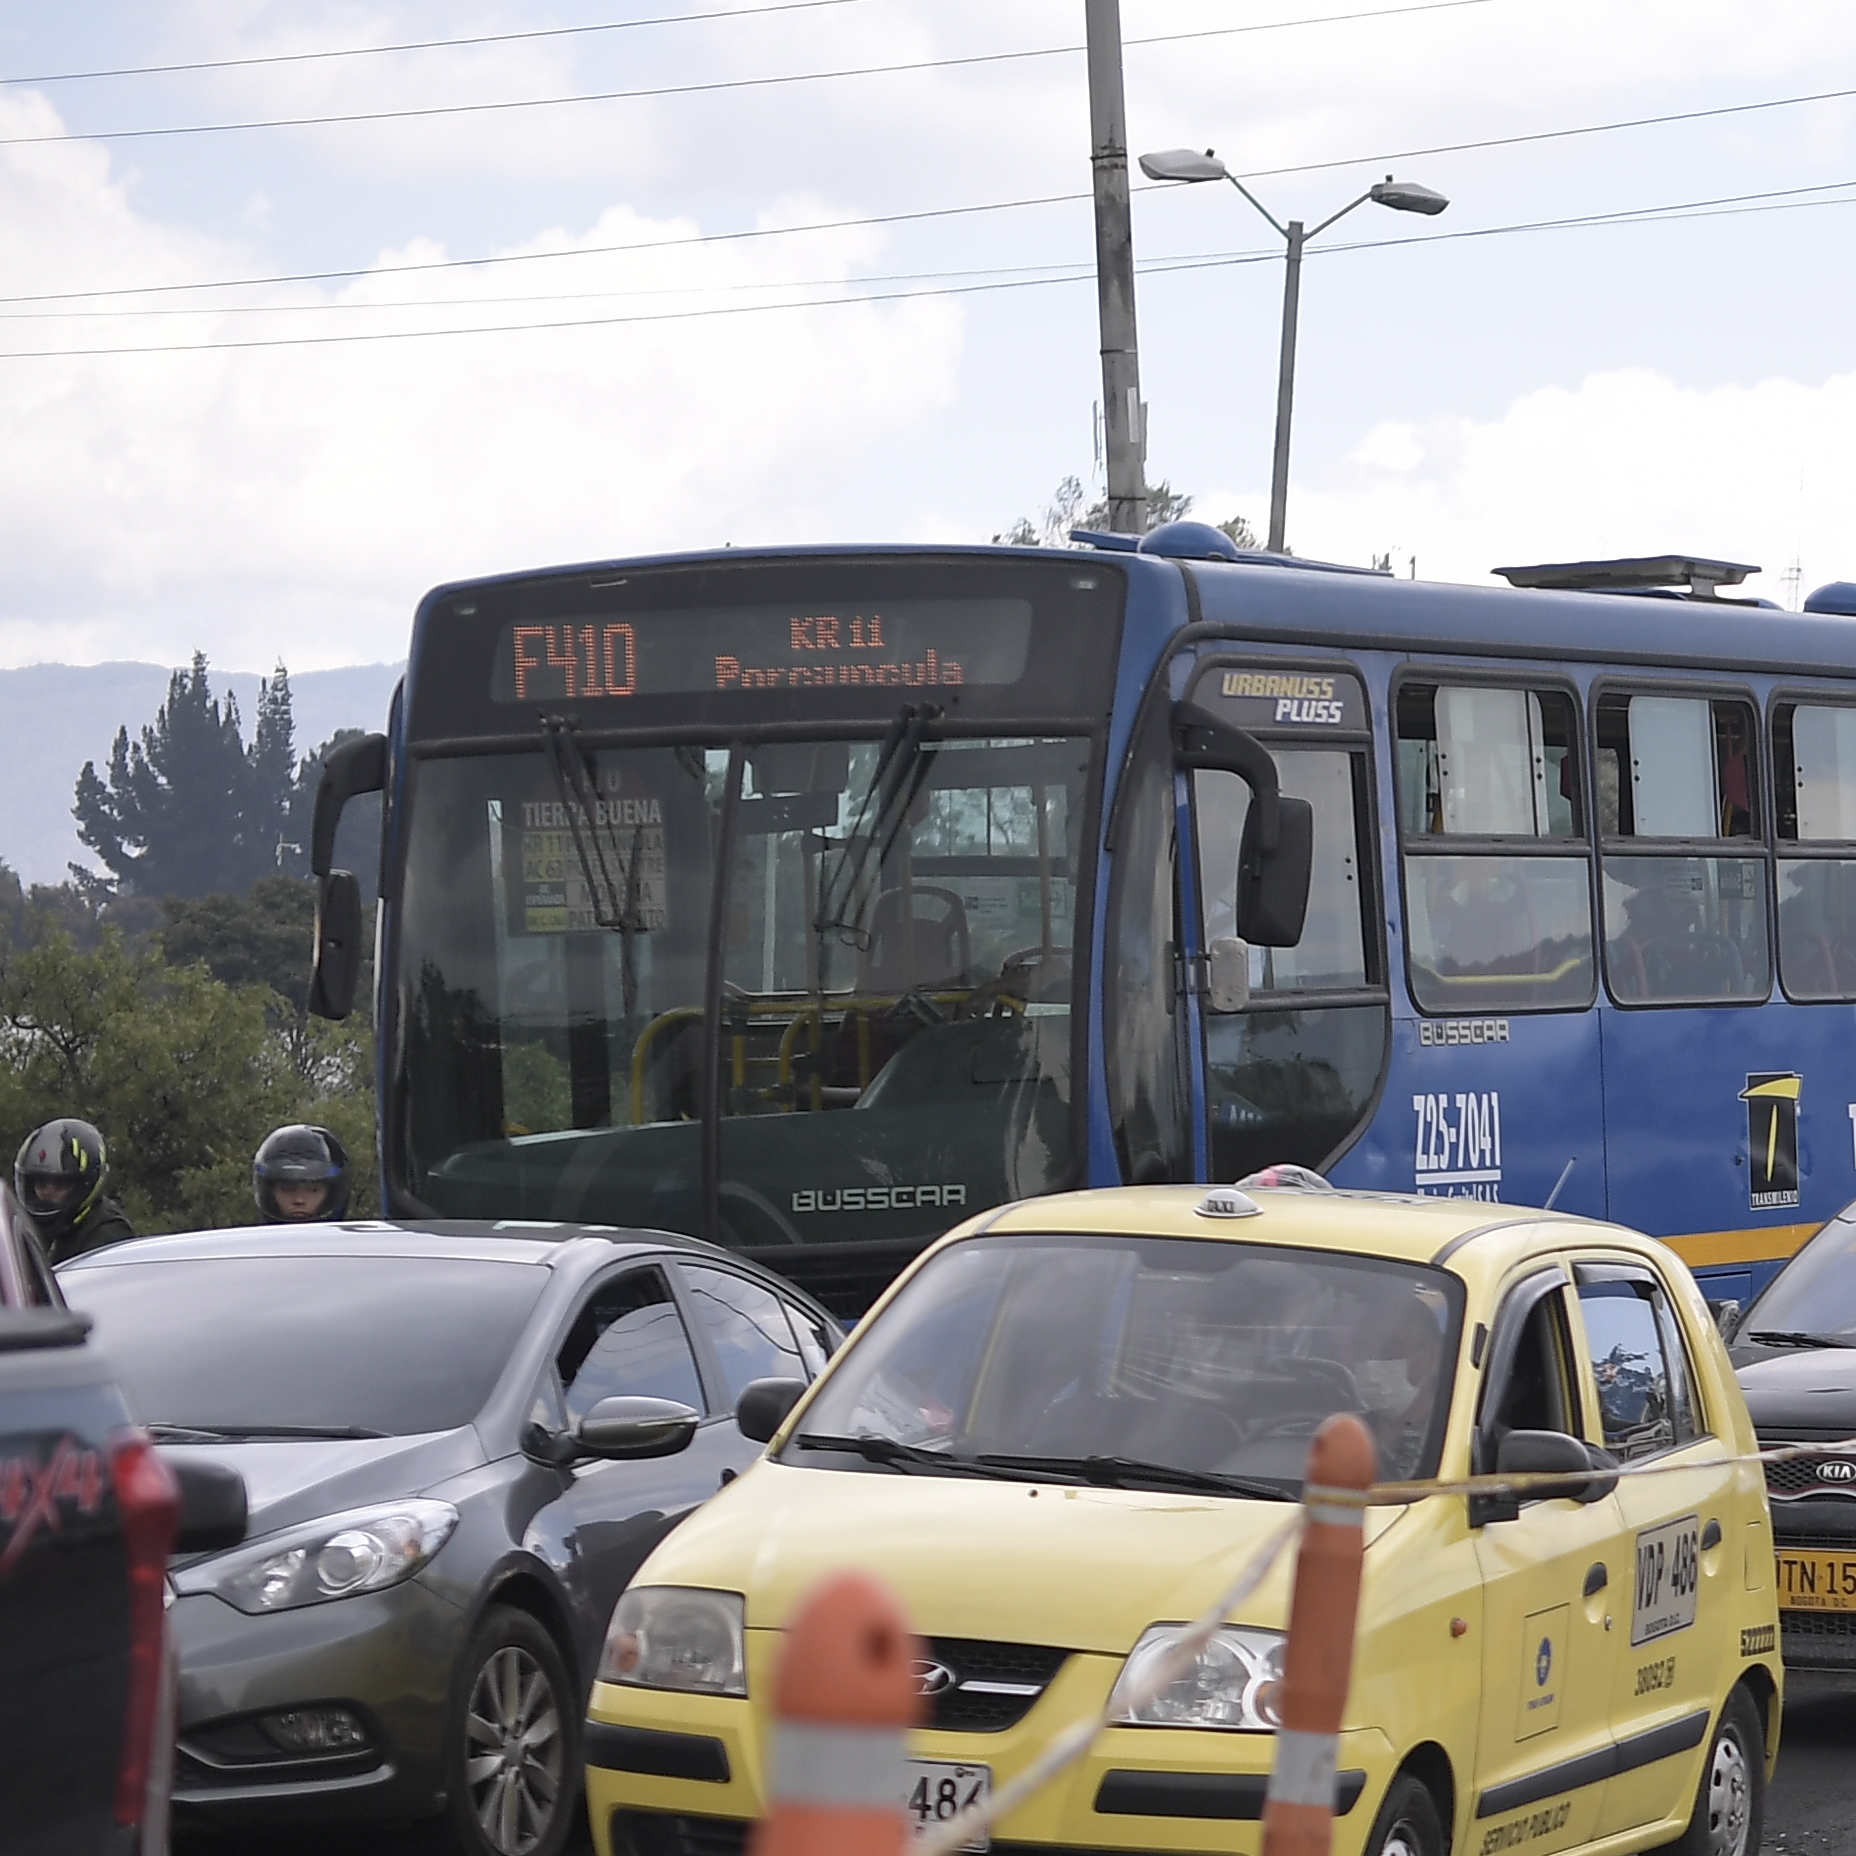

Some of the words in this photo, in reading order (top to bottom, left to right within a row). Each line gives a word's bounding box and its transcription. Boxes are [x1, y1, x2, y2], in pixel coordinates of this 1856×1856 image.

[790, 616, 841, 649] KR
[848, 614, 886, 648] 11
[512, 624, 636, 698] F410
[1222, 674, 1335, 699] URBANUSS
[1275, 699, 1344, 723] PLUSS
[1413, 1091, 1501, 1171] Z25-7041
[1822, 1463, 1851, 1479] KIA
[1790, 1594, 1827, 1606] BOGOTA
